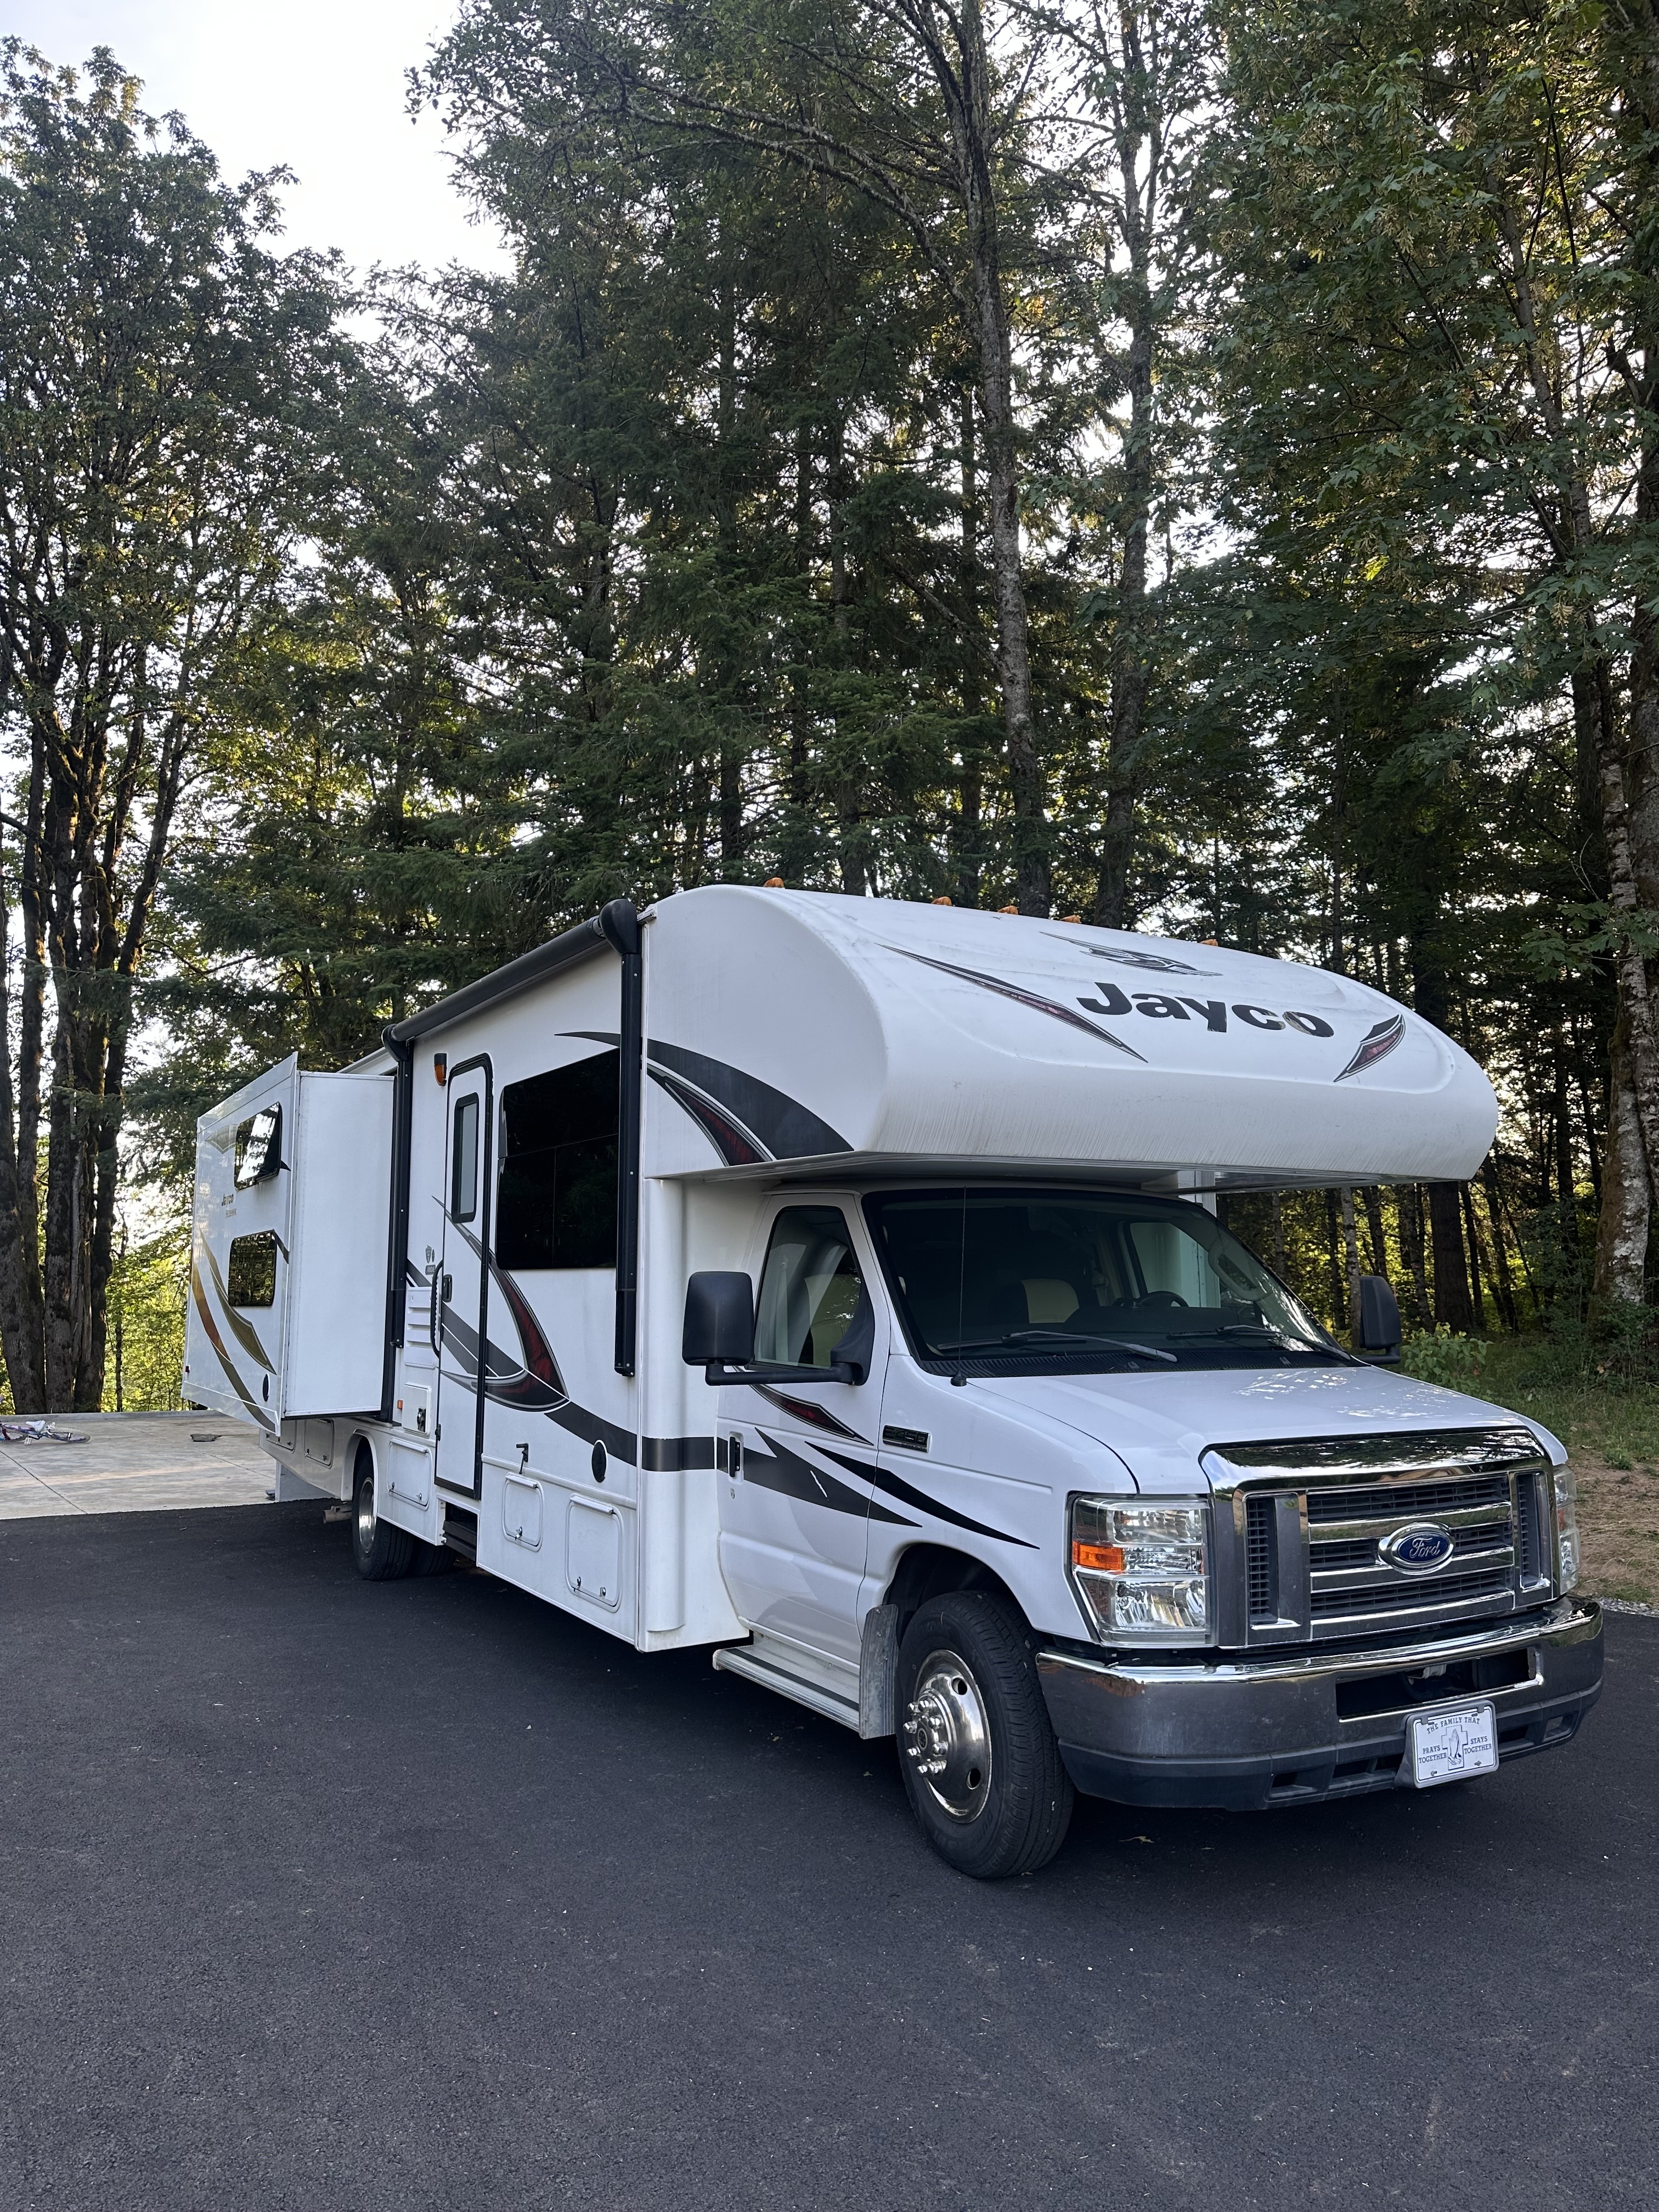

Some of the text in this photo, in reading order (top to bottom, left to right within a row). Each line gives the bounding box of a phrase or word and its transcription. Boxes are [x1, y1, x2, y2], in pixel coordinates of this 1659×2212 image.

[1076, 981, 1335, 1037] Jayco
[1409, 1537, 1441, 1559] Ford
[1427, 1717, 1480, 1734] THE FAMILY THAT
[1470, 1735, 1488, 1745] STAYS
[1423, 1745, 1441, 1754] PRAYS
[1464, 1743, 1492, 1754] TOGETHER
[1419, 1752, 1447, 1764] TOGETHER
